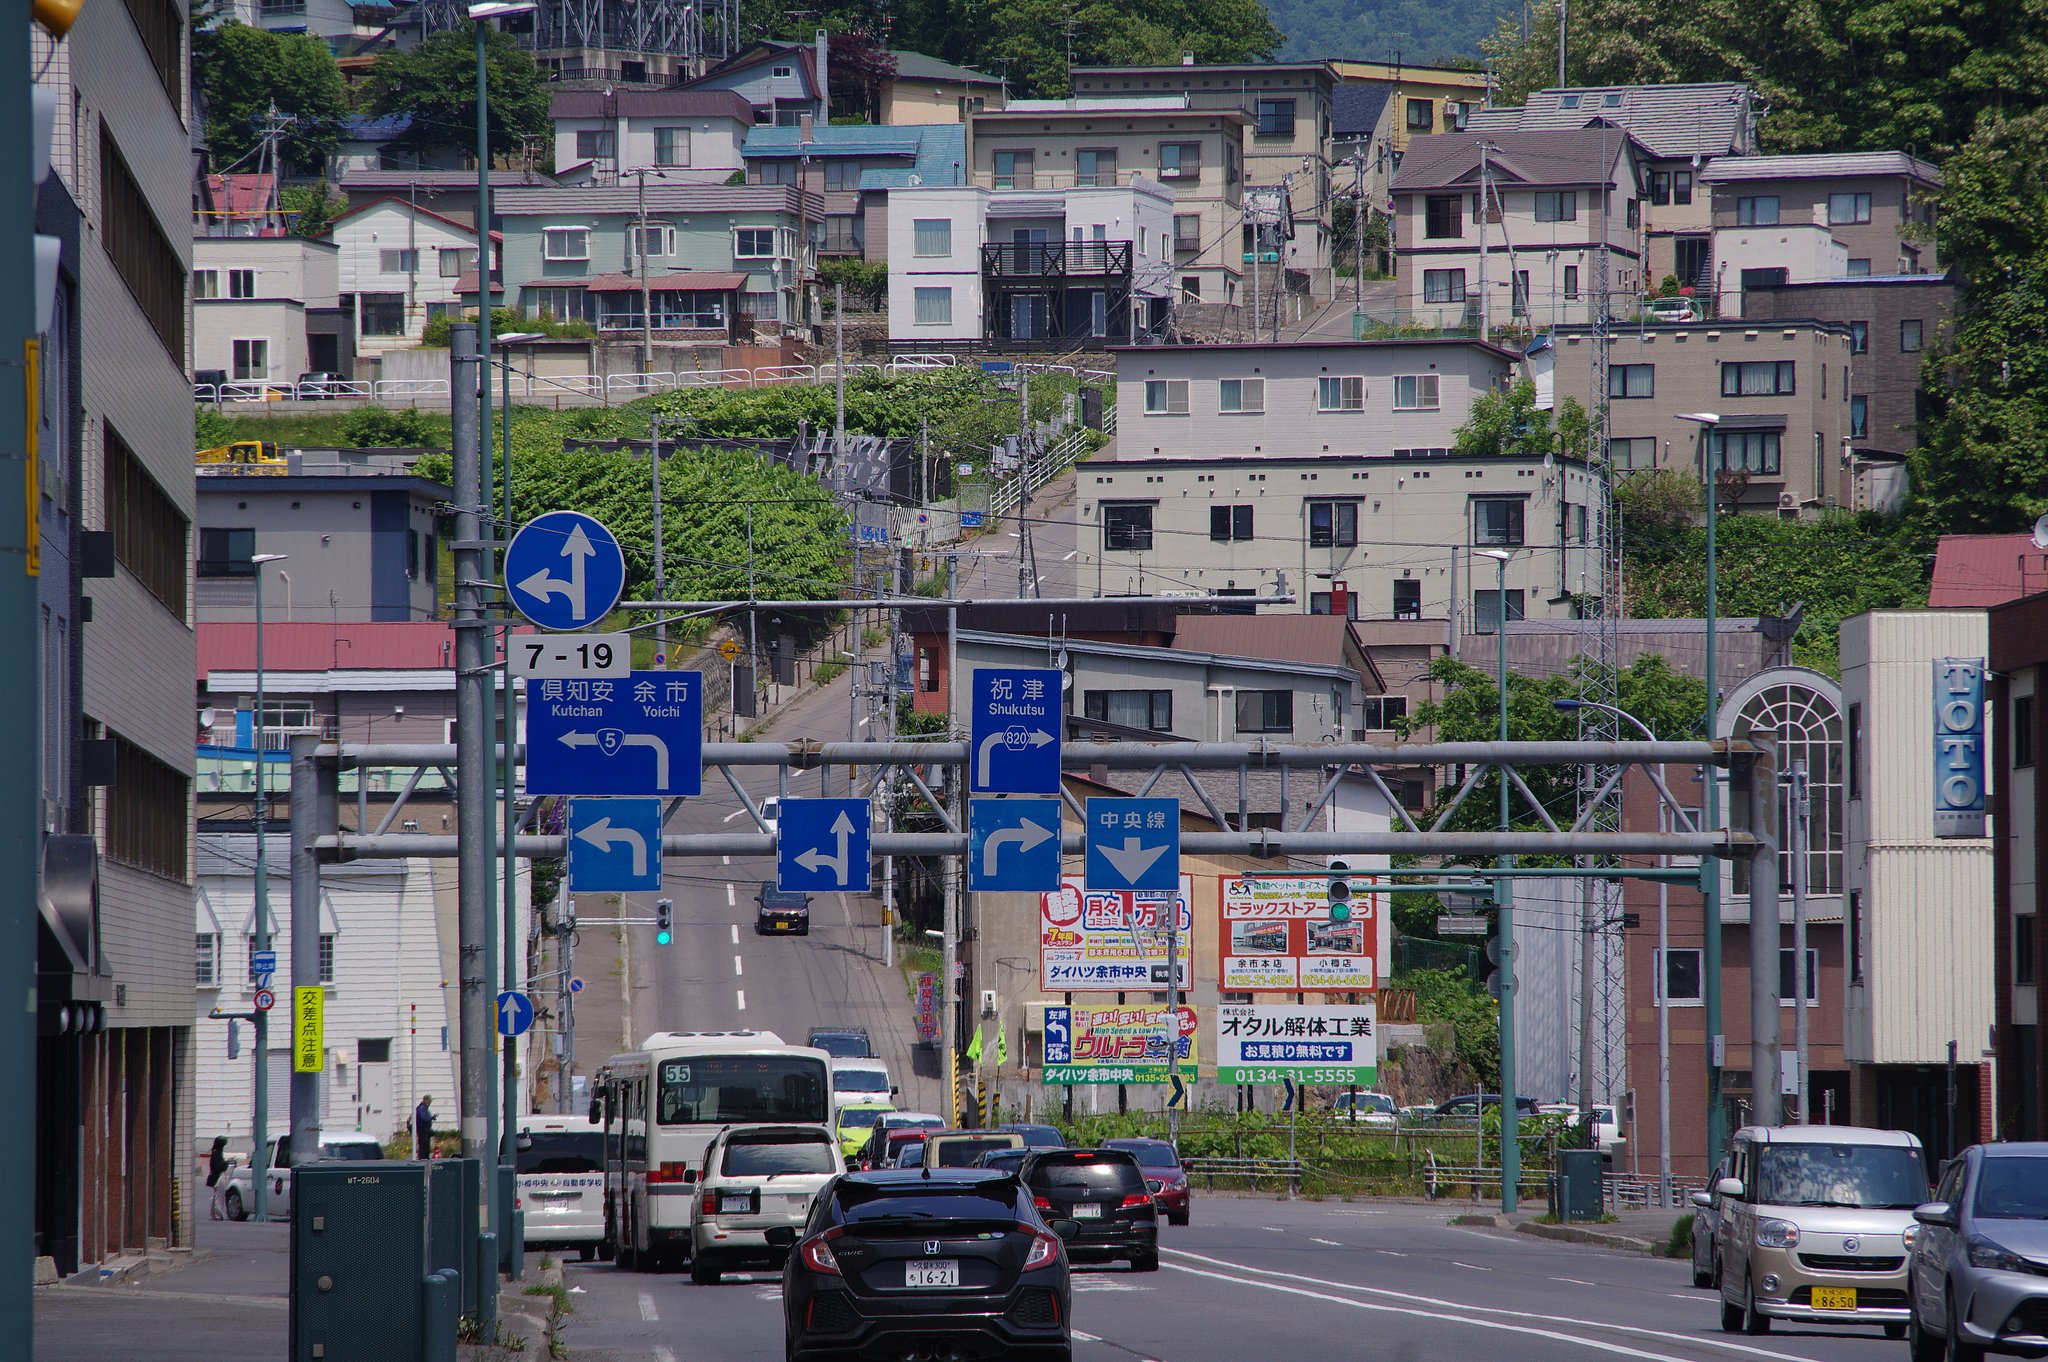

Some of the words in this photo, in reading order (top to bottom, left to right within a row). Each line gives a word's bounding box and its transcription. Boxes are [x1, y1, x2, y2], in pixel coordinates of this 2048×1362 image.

[633, 681, 688, 702] 余市
[990, 678, 1045, 701] 祝津
[551, 704, 603, 717] Kutchan
[642, 706, 680, 718] Yoichi
[988, 702, 1045, 716] Shukutsu
[604, 733, 616, 748] 5
[1006, 732, 1027, 744] 820
[1943, 664, 1977, 807] TOTO
[1100, 811, 1165, 829] 中央線
[1238, 959, 1282, 968] 余市本店
[1319, 959, 1352, 968] 小樽店
[1050, 965, 1147, 979] ダイハツ余市中央
[1049, 1010, 1067, 1019] 左折
[1222, 1008, 1256, 1016] 株式会社
[302, 991, 317, 1068] 交差点注意
[1222, 1017, 1372, 1037] オタル解体工業
[1245, 1044, 1348, 1059] お見積り無料です
[666, 1066, 690, 1081] 55
[1046, 1069, 1134, 1081] ダイハツ余市中央
[1235, 1069, 1356, 1083] 0134-31-5555
[920, 1270, 954, 1284] 16-21
[1821, 1296, 1854, 1308] 86-50
